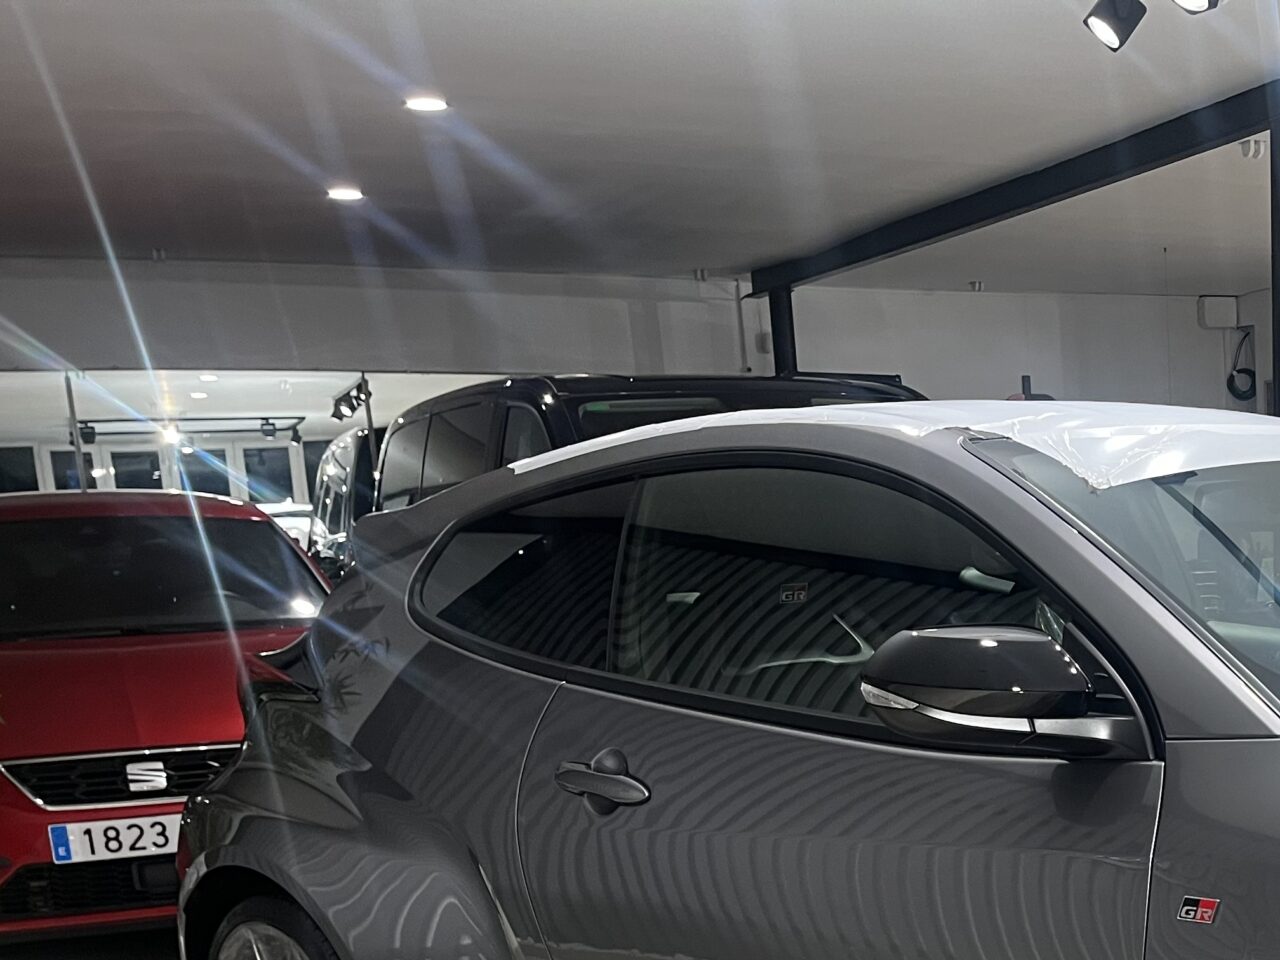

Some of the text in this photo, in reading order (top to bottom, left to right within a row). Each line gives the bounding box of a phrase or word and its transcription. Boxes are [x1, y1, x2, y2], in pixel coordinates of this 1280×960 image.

[782, 591, 805, 601] GR
[83, 821, 170, 855] 1823
[1180, 905, 1213, 921] GR
